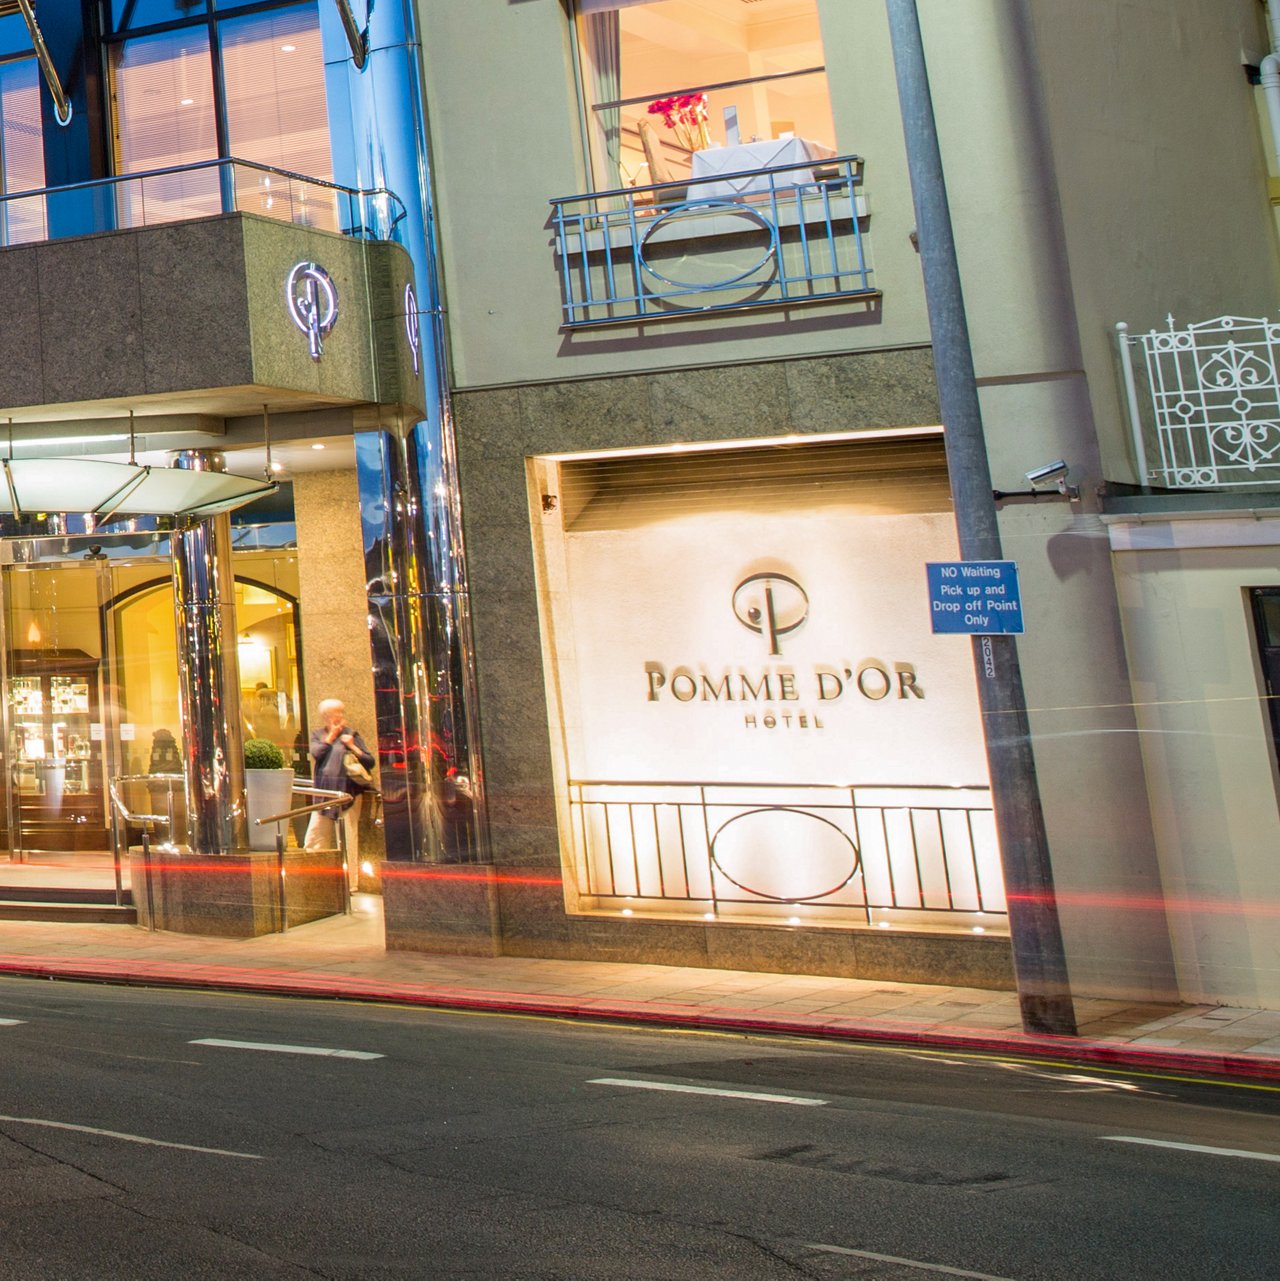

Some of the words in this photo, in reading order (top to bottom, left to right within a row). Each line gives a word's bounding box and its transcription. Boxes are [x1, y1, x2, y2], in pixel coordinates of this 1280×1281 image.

[941, 567, 957, 578] NO
[961, 566, 1001, 579] Waiting
[941, 585, 963, 596] Pick
[967, 588, 981, 597] up
[985, 584, 1006, 595] and
[933, 601, 960, 613] Drop
[965, 600, 982, 611] off
[987, 600, 1018, 611] Point
[964, 614, 989, 627] Only
[982, 637, 993, 677] 2042
[646, 666, 800, 702] POMME
[814, 660, 926, 701] D'OR
[744, 712, 825, 729] HOTEL
